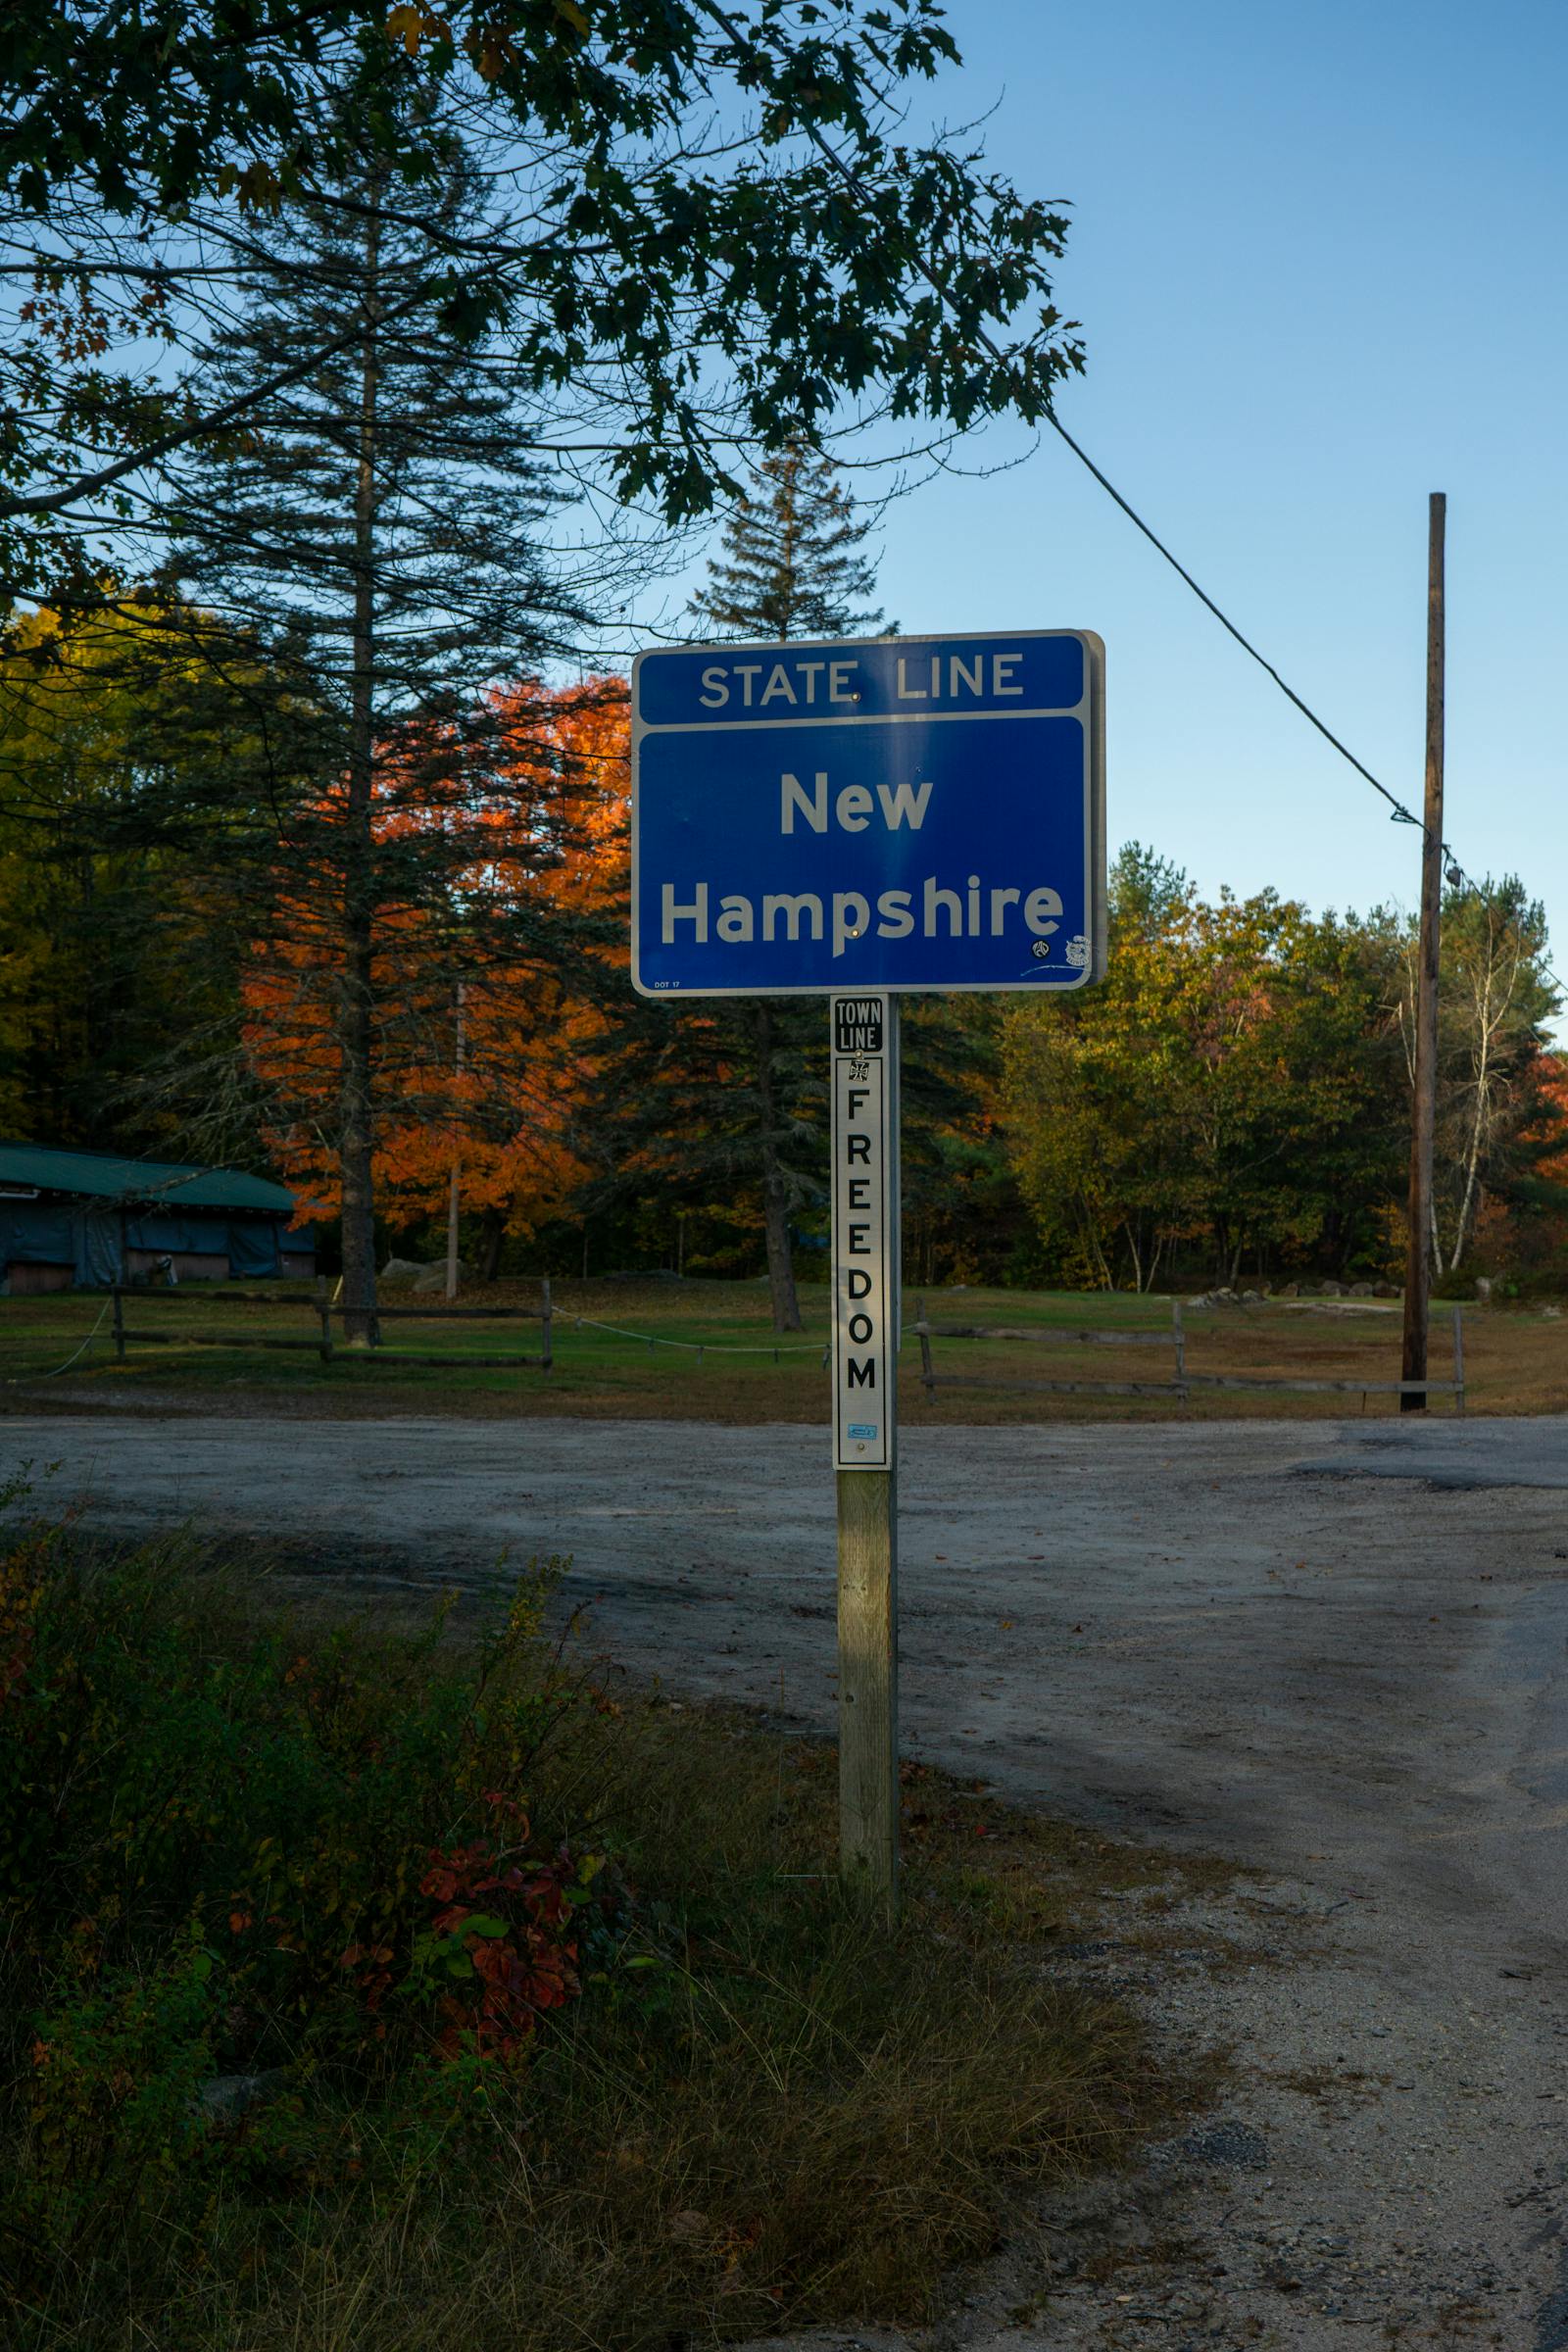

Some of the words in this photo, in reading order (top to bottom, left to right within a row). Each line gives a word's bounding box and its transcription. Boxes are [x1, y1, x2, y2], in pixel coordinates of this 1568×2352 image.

[699, 661, 858, 708] STATE
[898, 653, 1024, 699] LINE
[780, 772, 933, 834] New
[662, 874, 1063, 958] Hampshire
[836, 1002, 881, 1025] TOWN
[840, 1026, 876, 1049] LINE
[847, 1089, 876, 1389] FREEDOM
